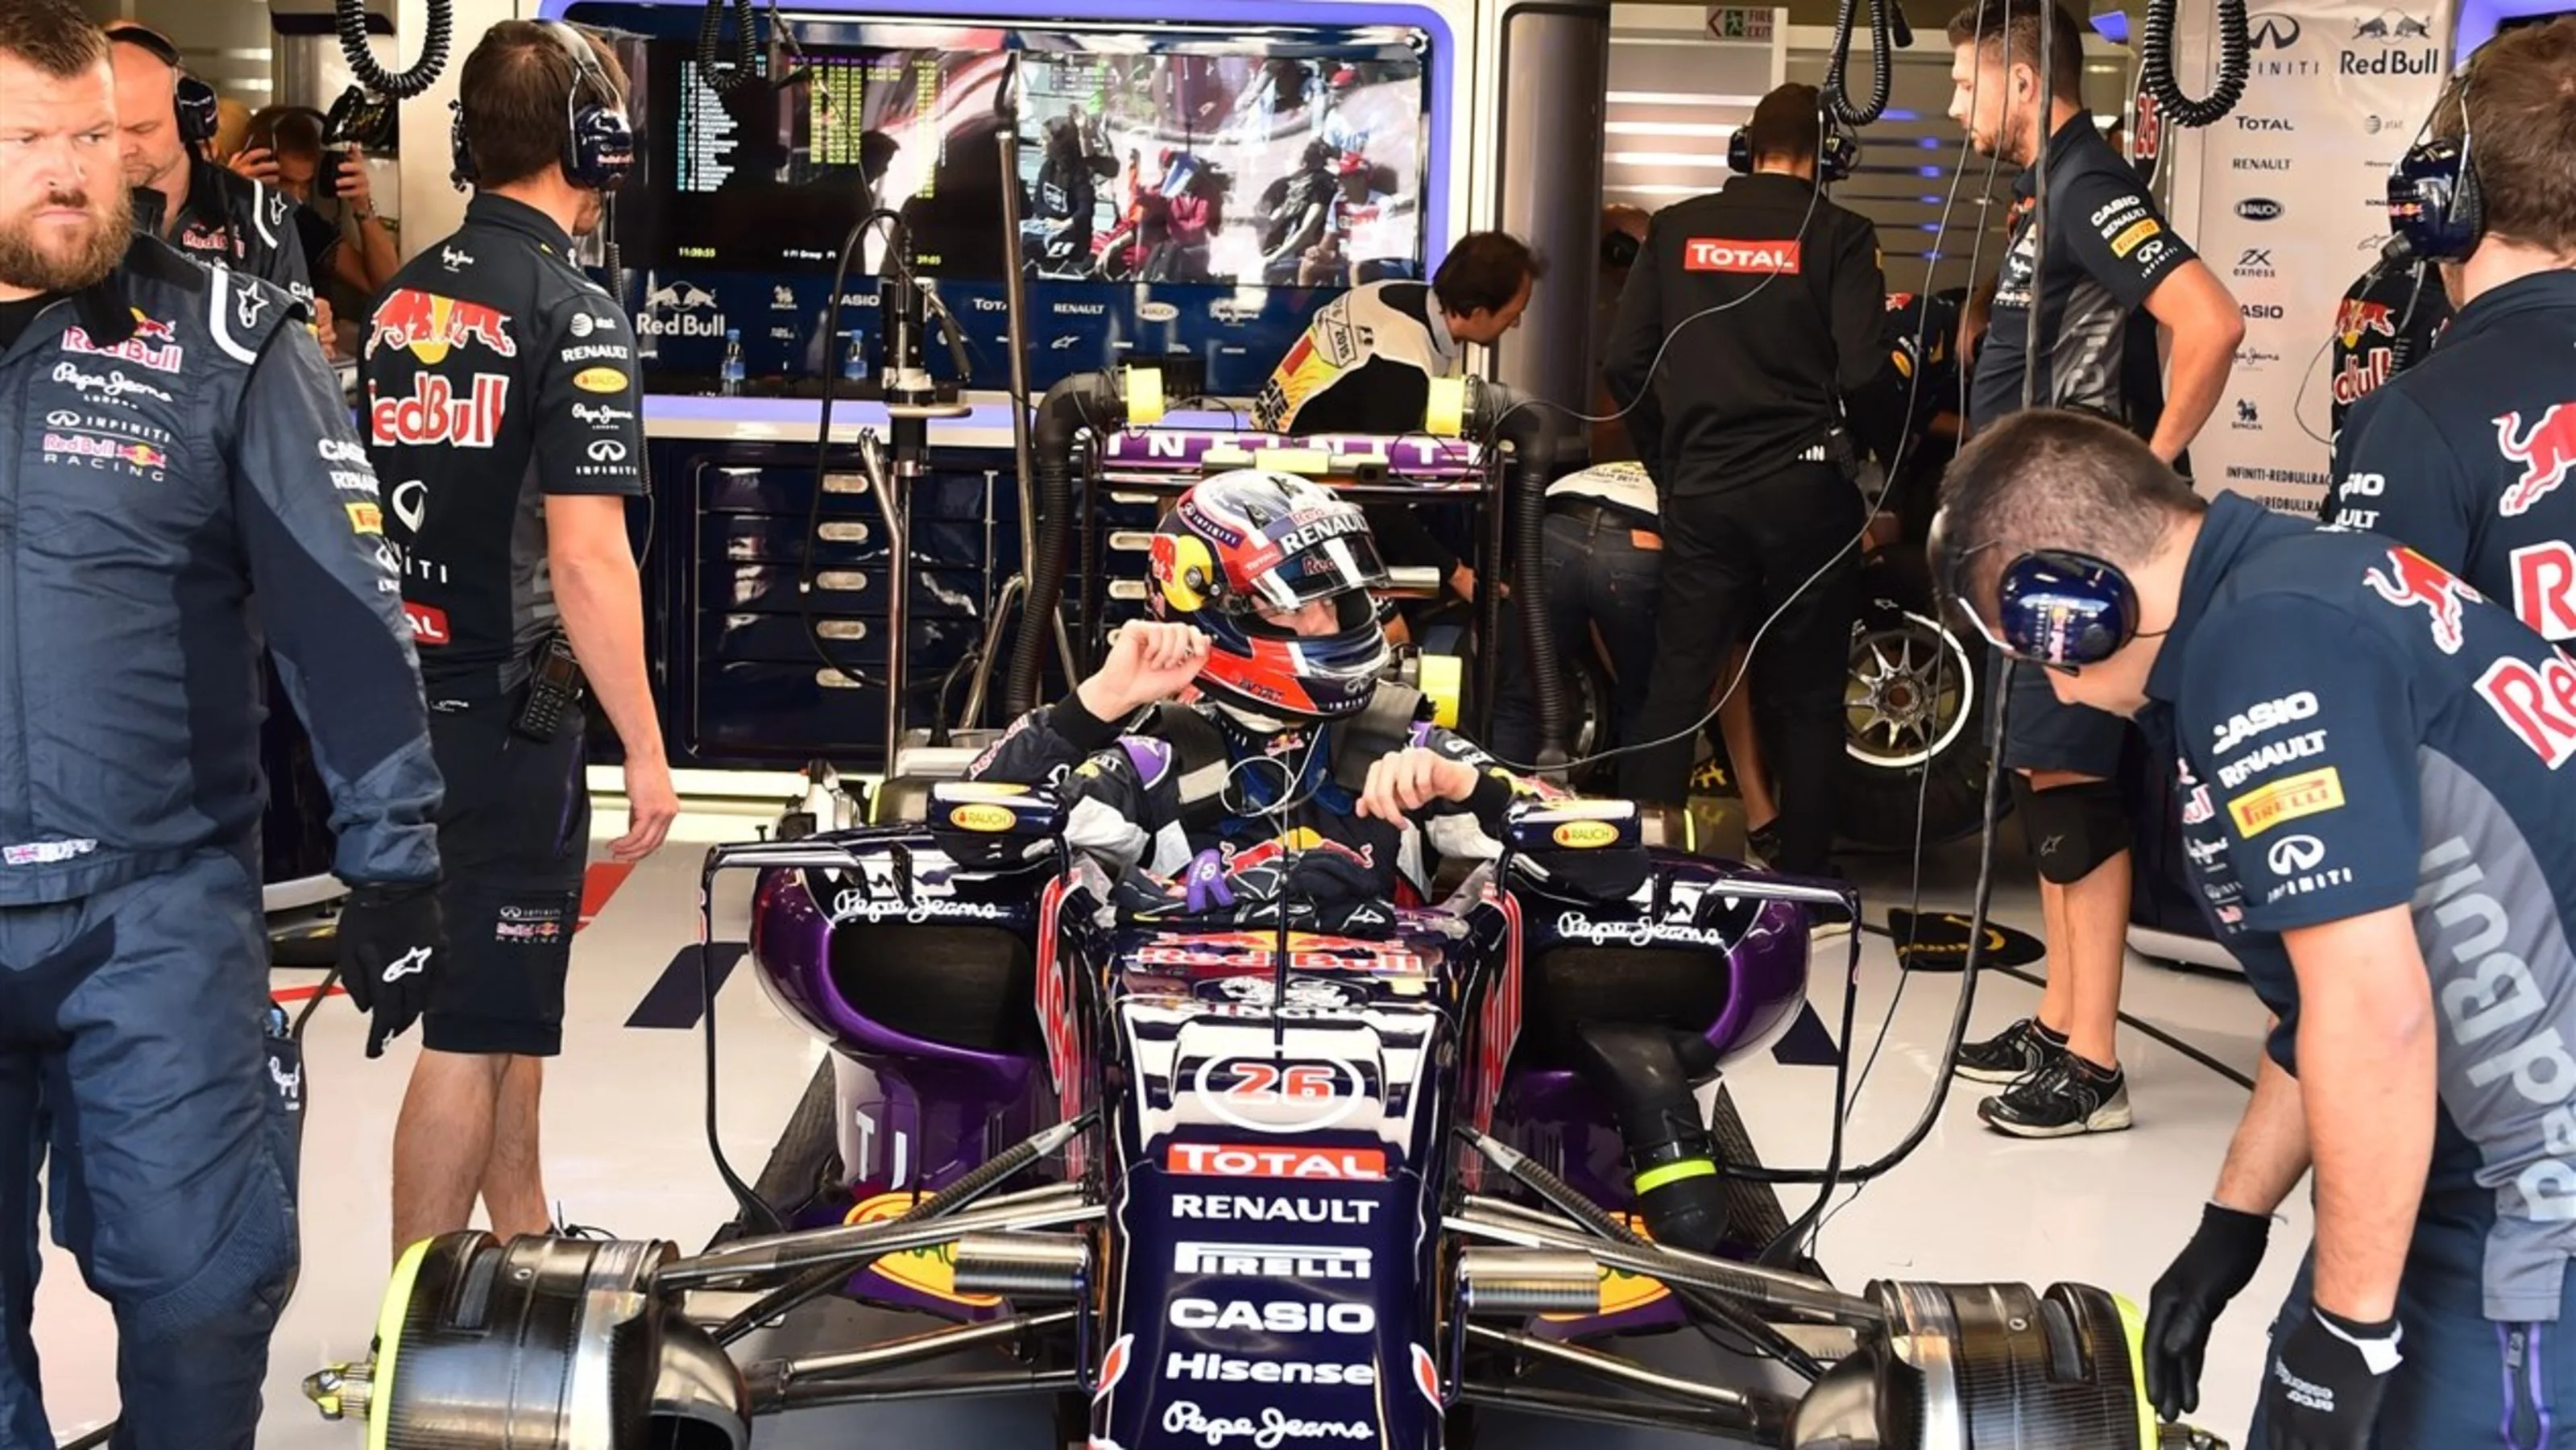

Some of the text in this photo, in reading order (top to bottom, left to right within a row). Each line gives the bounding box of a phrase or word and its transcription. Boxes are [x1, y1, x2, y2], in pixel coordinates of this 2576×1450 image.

[1748, 10, 1772, 23] FIRE
[1747, 27, 1771, 37] EXIT
[2216, 61, 2320, 76] IINITI
[2339, 48, 2439, 75] Red Bull
[2235, 117, 2294, 131] TOTAL
[2232, 159, 2290, 170] RENAULT
[2090, 194, 2140, 227] CASIO
[1692, 243, 1794, 267] TOTAL
[2233, 267, 2276, 278] exness
[974, 298, 1008, 311] TOT
[1054, 303, 1104, 315] RENAULT
[2240, 304, 2284, 319] ASIO
[636, 313, 726, 337] Red Bull
[124, 338, 184, 374] Bull
[561, 345, 627, 362] RENAULT
[52, 362, 174, 403] Pepe Jeans
[368, 371, 429, 446] ed
[87, 416, 170, 442] INFINITI
[43, 433, 117, 458] Red Bull
[43, 453, 164, 482] RACING
[575, 466, 637, 475] INFINITI
[2226, 466, 2333, 485] INFINITI-REDBULLRAC
[1193, 513, 1239, 545] INFINITI
[2214, 691, 2319, 754] CASIO
[2473, 657, 2576, 770] Re
[969, 810, 1008, 824] RAUCH
[2240, 778, 2330, 828] PIRELLI
[1571, 826, 1610, 839] RAUCH
[2267, 867, 2353, 904] INITI
[834, 888, 1011, 923] Pepe Jeans
[1558, 911, 1725, 947] Pepe Jeans
[2412, 835, 2547, 1046] Bull
[1137, 947, 1423, 972] Red Bull
[1226, 1063, 1336, 1107] 26
[1173, 1143, 1380, 1180] TOTAL
[1171, 1194, 1379, 1224] RENAULT
[1174, 1241, 1373, 1279] PIRELLI
[1169, 1299, 1376, 1333] CASIO
[1166, 1352, 1375, 1386] Hisense
[1162, 1400, 1374, 1450] Pepe Jeans
